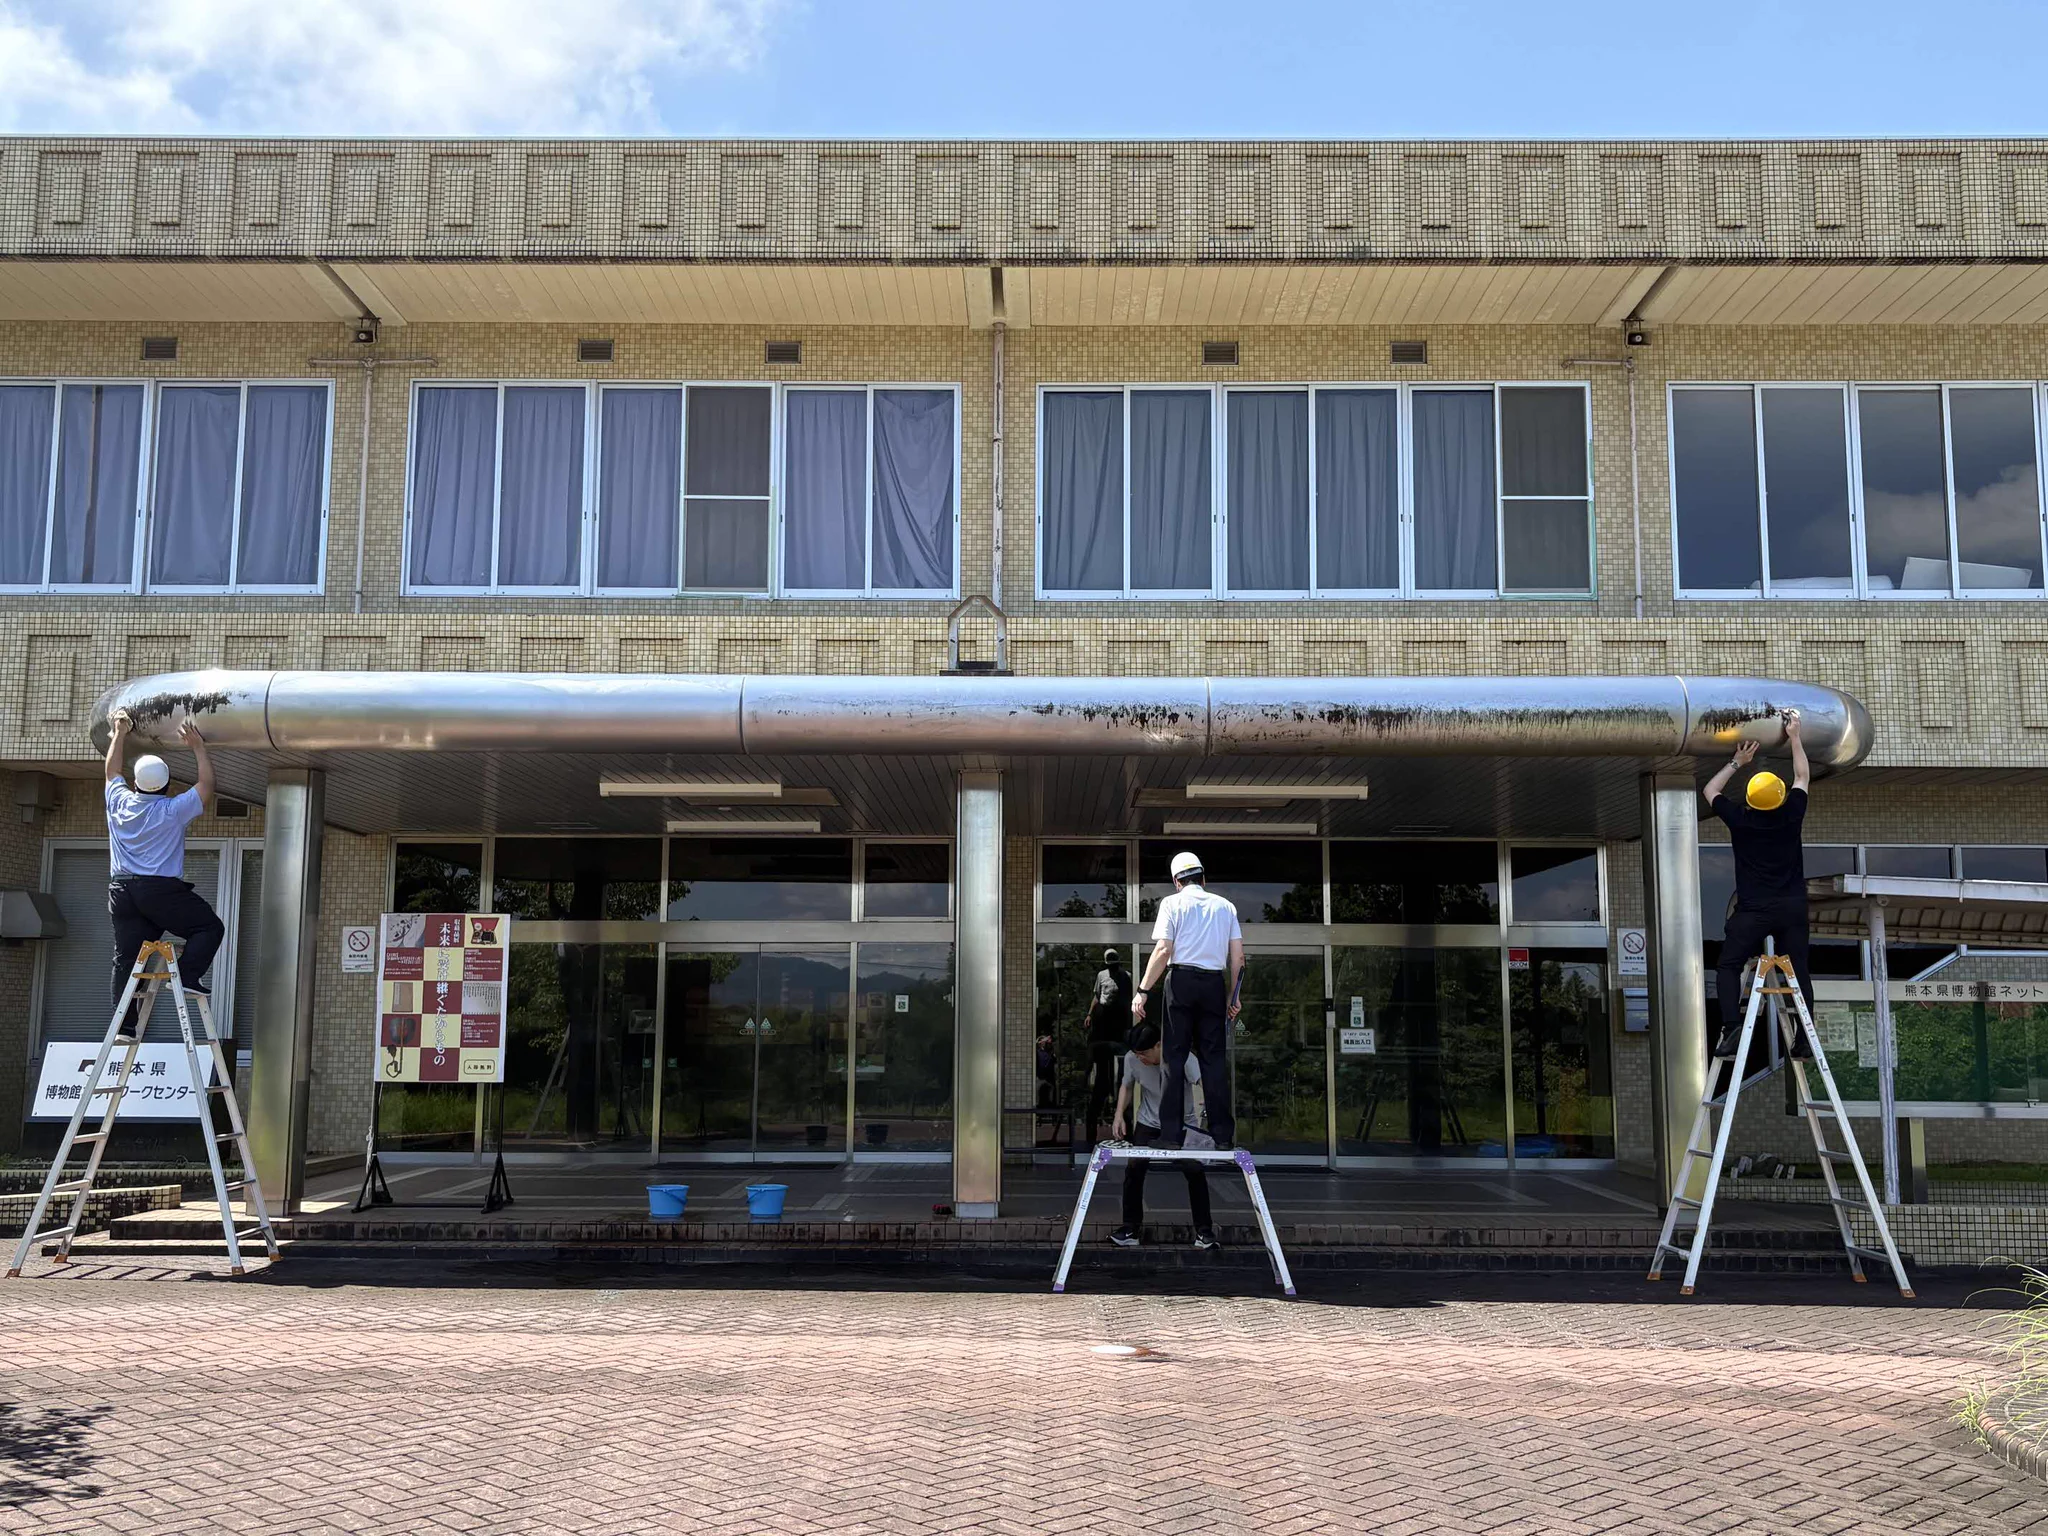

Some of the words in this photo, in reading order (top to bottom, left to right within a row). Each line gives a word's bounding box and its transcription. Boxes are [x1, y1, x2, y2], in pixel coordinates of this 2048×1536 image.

[433, 922, 451, 1066] 未来に受け継ぐたからもの
[1904, 984, 2044, 999] 熊本県博物館ネット
